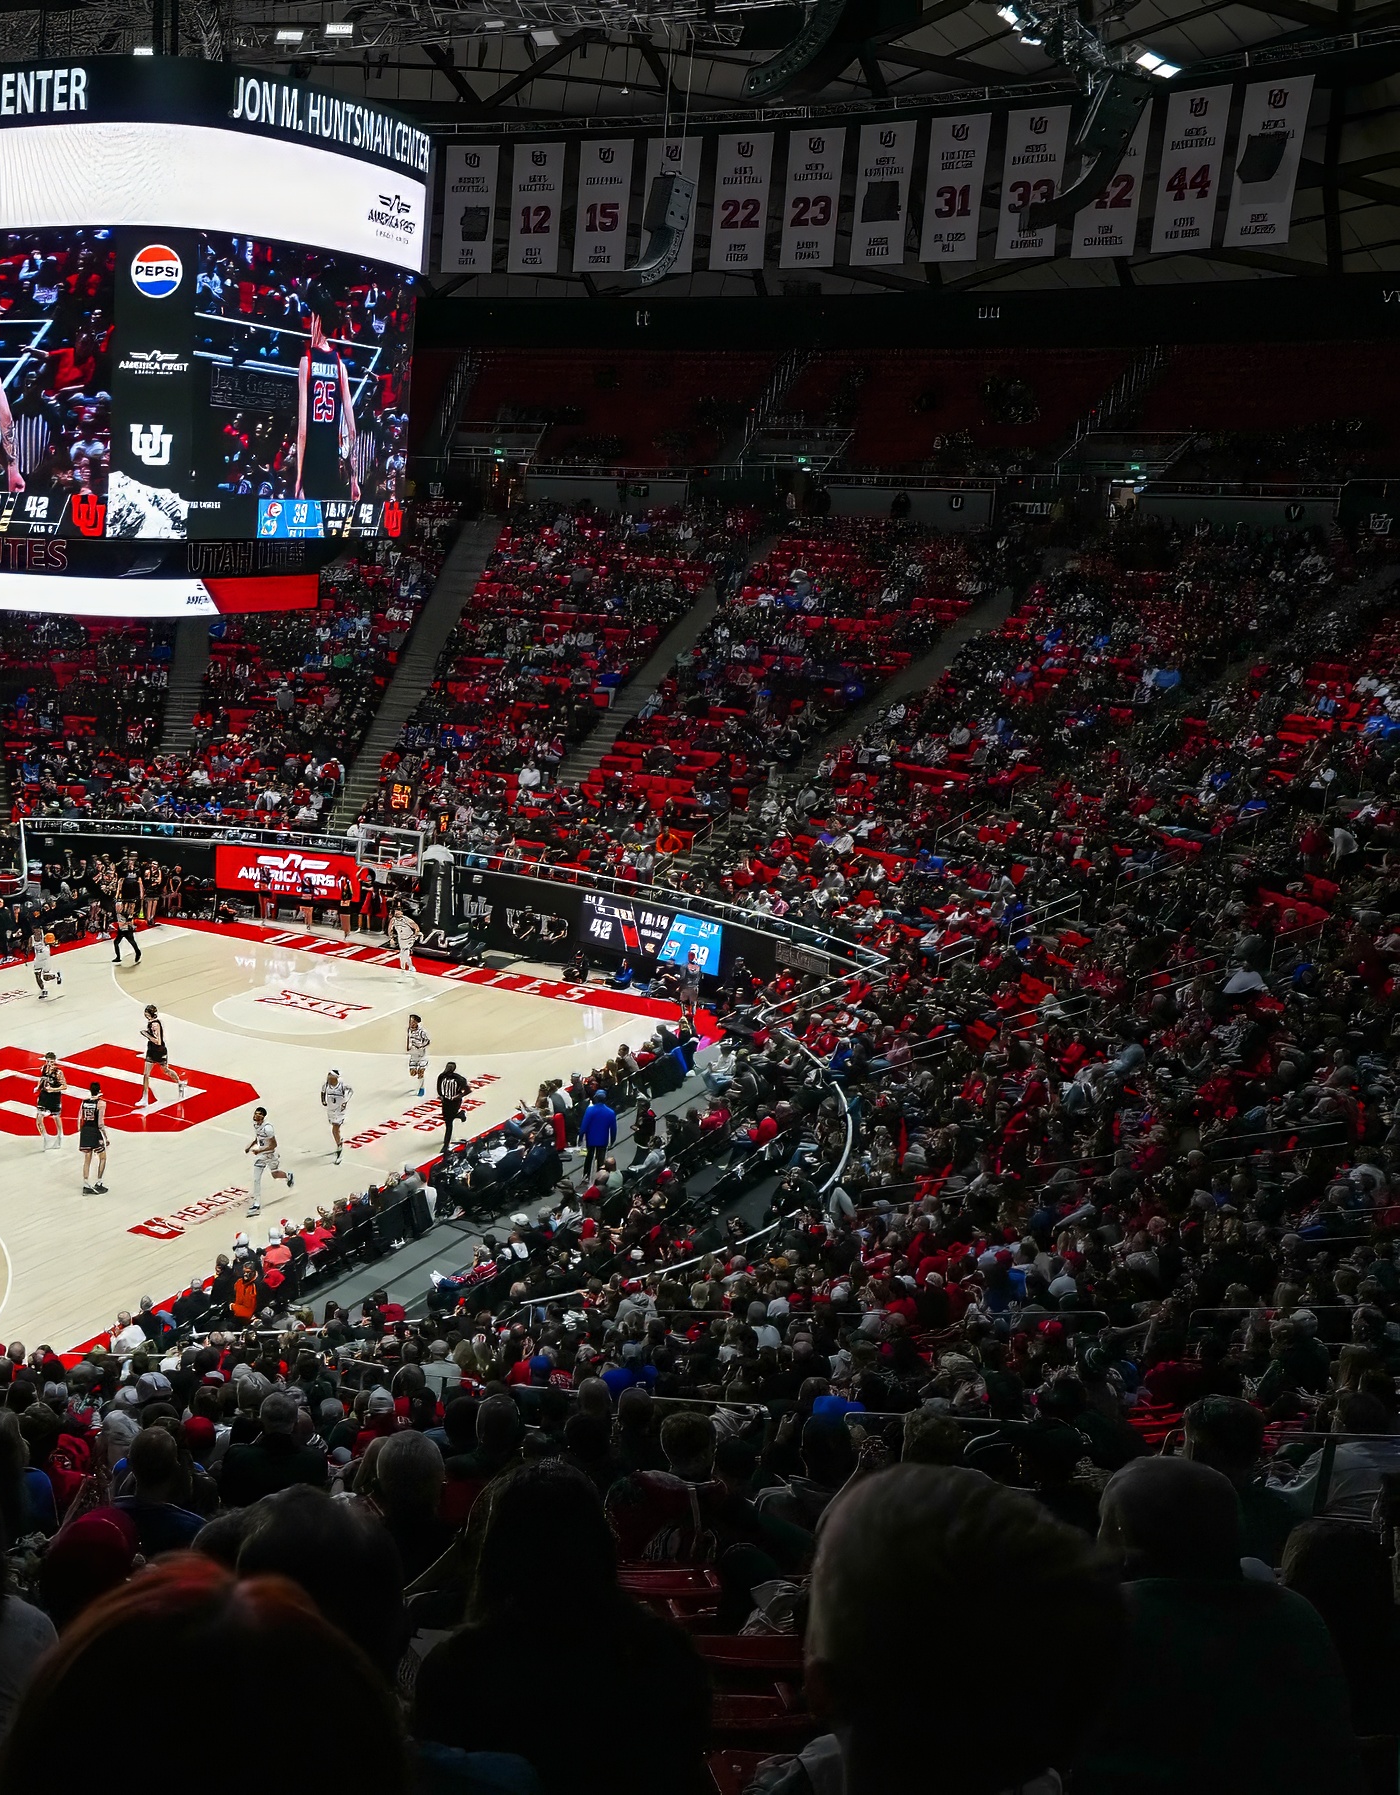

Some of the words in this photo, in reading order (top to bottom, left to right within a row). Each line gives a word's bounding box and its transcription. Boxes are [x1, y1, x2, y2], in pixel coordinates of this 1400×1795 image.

[232, 76, 277, 126] JON
[280, 85, 304, 132] M.
[307, 92, 394, 158] HUNTSMAN
[394, 121, 431, 174] CENTER
[1165, 164, 1212, 201] 44
[720, 198, 761, 229] 22
[789, 195, 832, 228] 23
[935, 184, 971, 219] 31
[519, 205, 552, 234] 12
[585, 203, 620, 232] 15
[135, 265, 179, 278] PEPSI
[313, 380, 336, 423] 25
[24, 495, 49, 518] 42
[292, 503, 308, 524] 39
[187, 542, 254, 573] UTAH
[589, 918, 613, 940] 42
[263, 932, 401, 965] UTAH
[441, 965, 595, 1001] UTES
[170, 1187, 250, 1222] HEALTH
